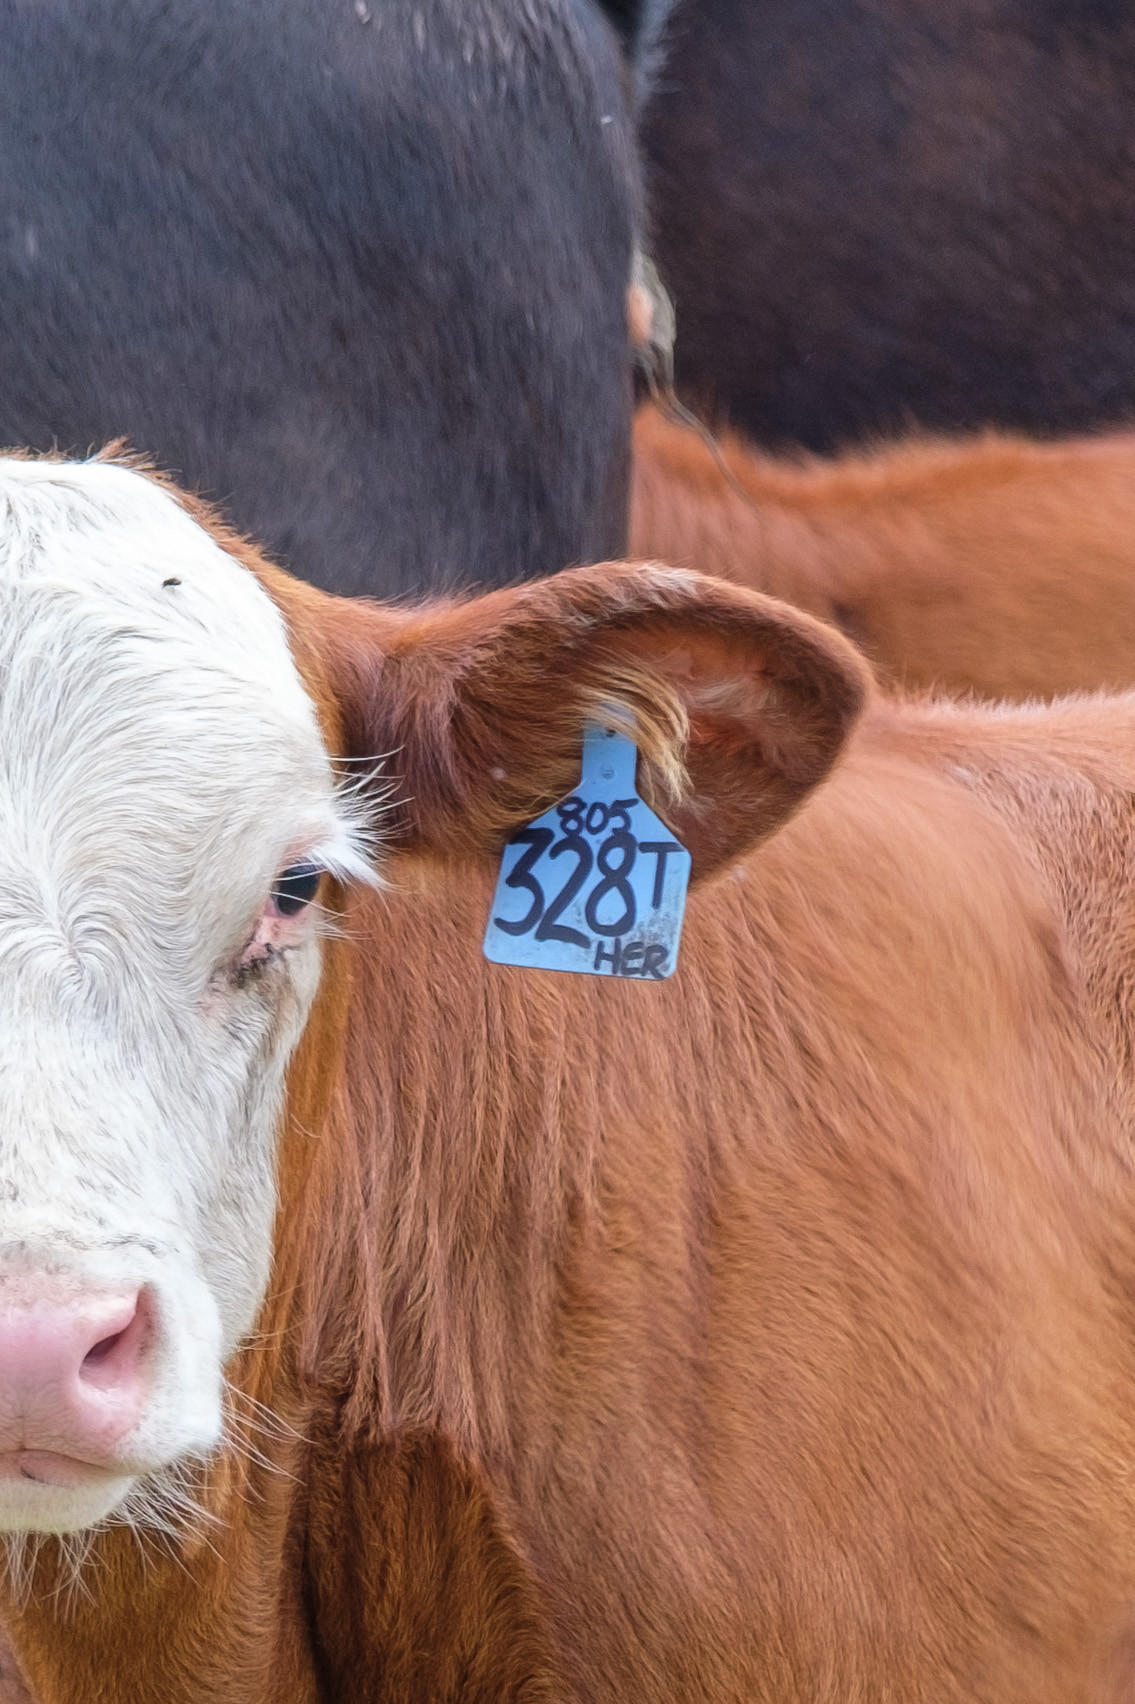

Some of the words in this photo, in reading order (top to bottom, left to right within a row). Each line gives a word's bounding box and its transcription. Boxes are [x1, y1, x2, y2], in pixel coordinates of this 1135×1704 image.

[557, 796, 639, 836] 805
[494, 828, 685, 949] 328T
[594, 938, 670, 980] HER
